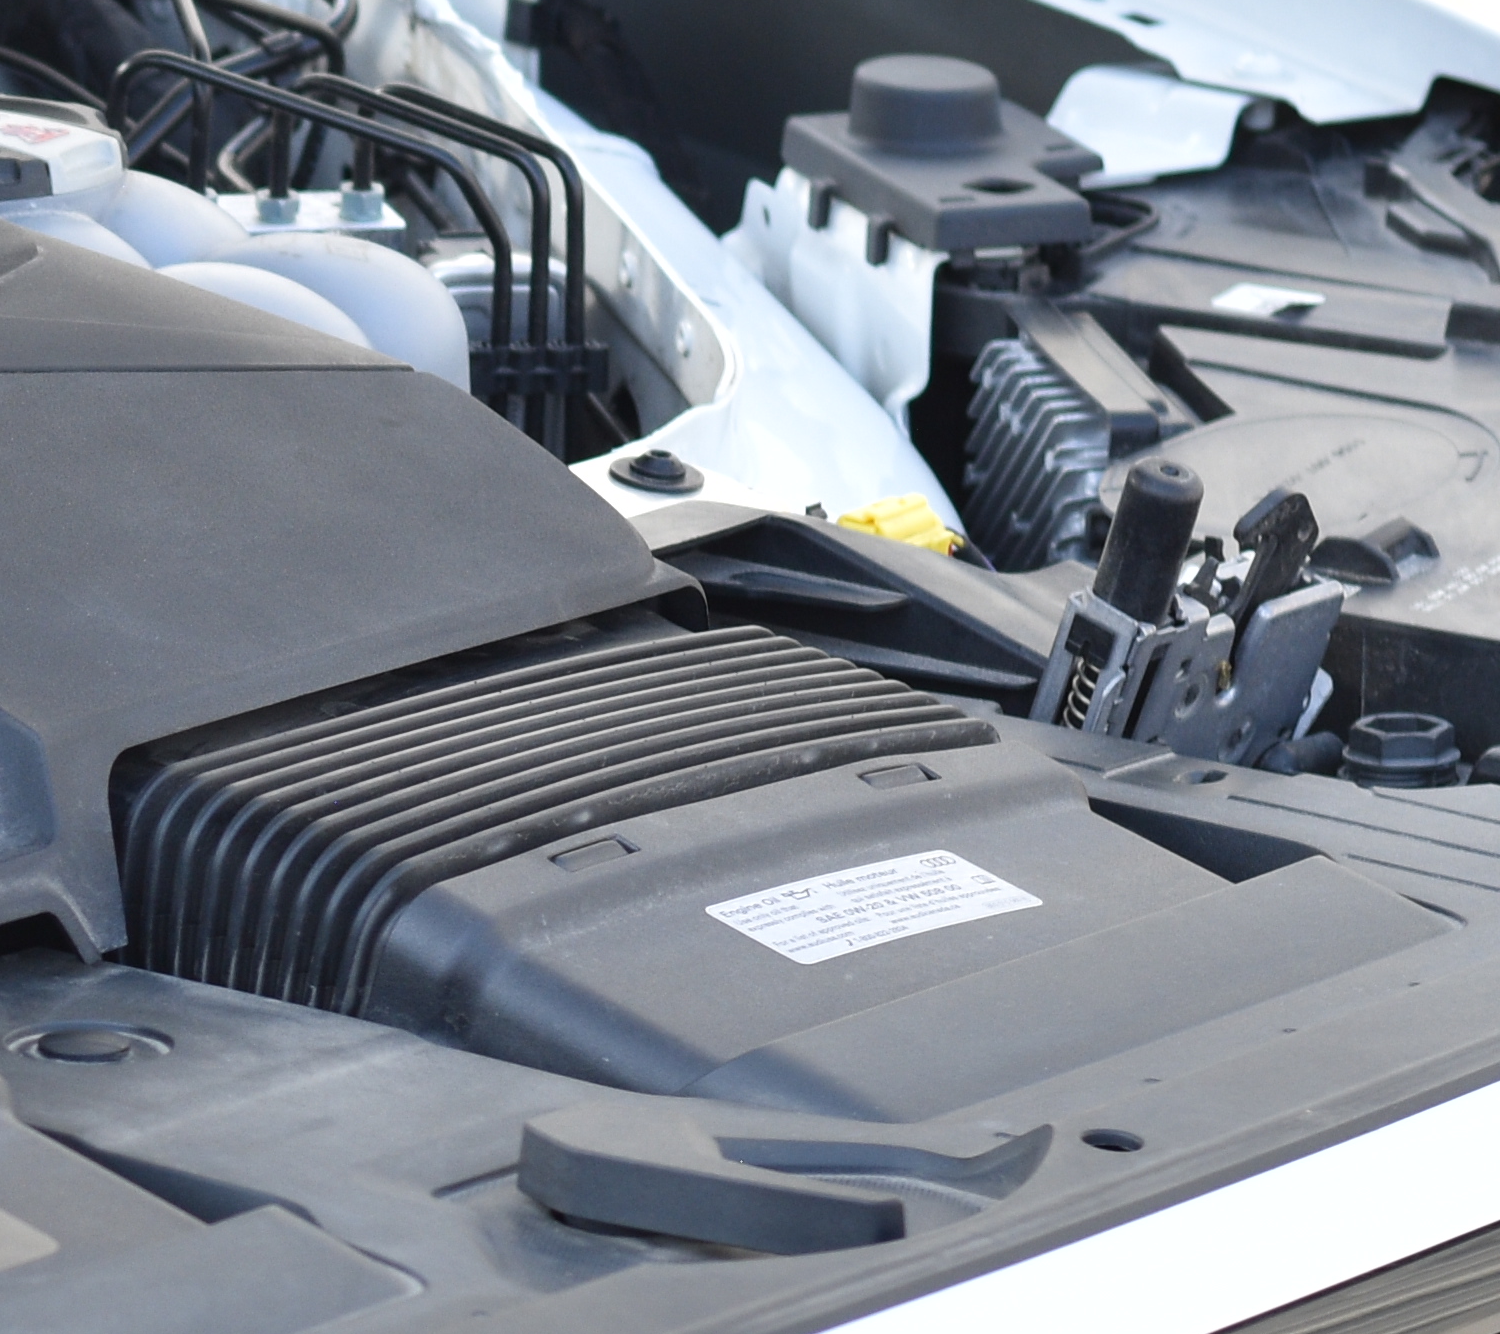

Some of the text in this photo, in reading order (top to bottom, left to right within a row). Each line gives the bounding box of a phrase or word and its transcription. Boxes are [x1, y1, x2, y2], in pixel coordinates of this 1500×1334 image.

[822, 868, 898, 889] Huile moteur
[719, 897, 781, 918] Engine Oil
[815, 911, 846, 924] SAE
[842, 902, 884, 916] 0W-20
[919, 887, 945, 897] 508
